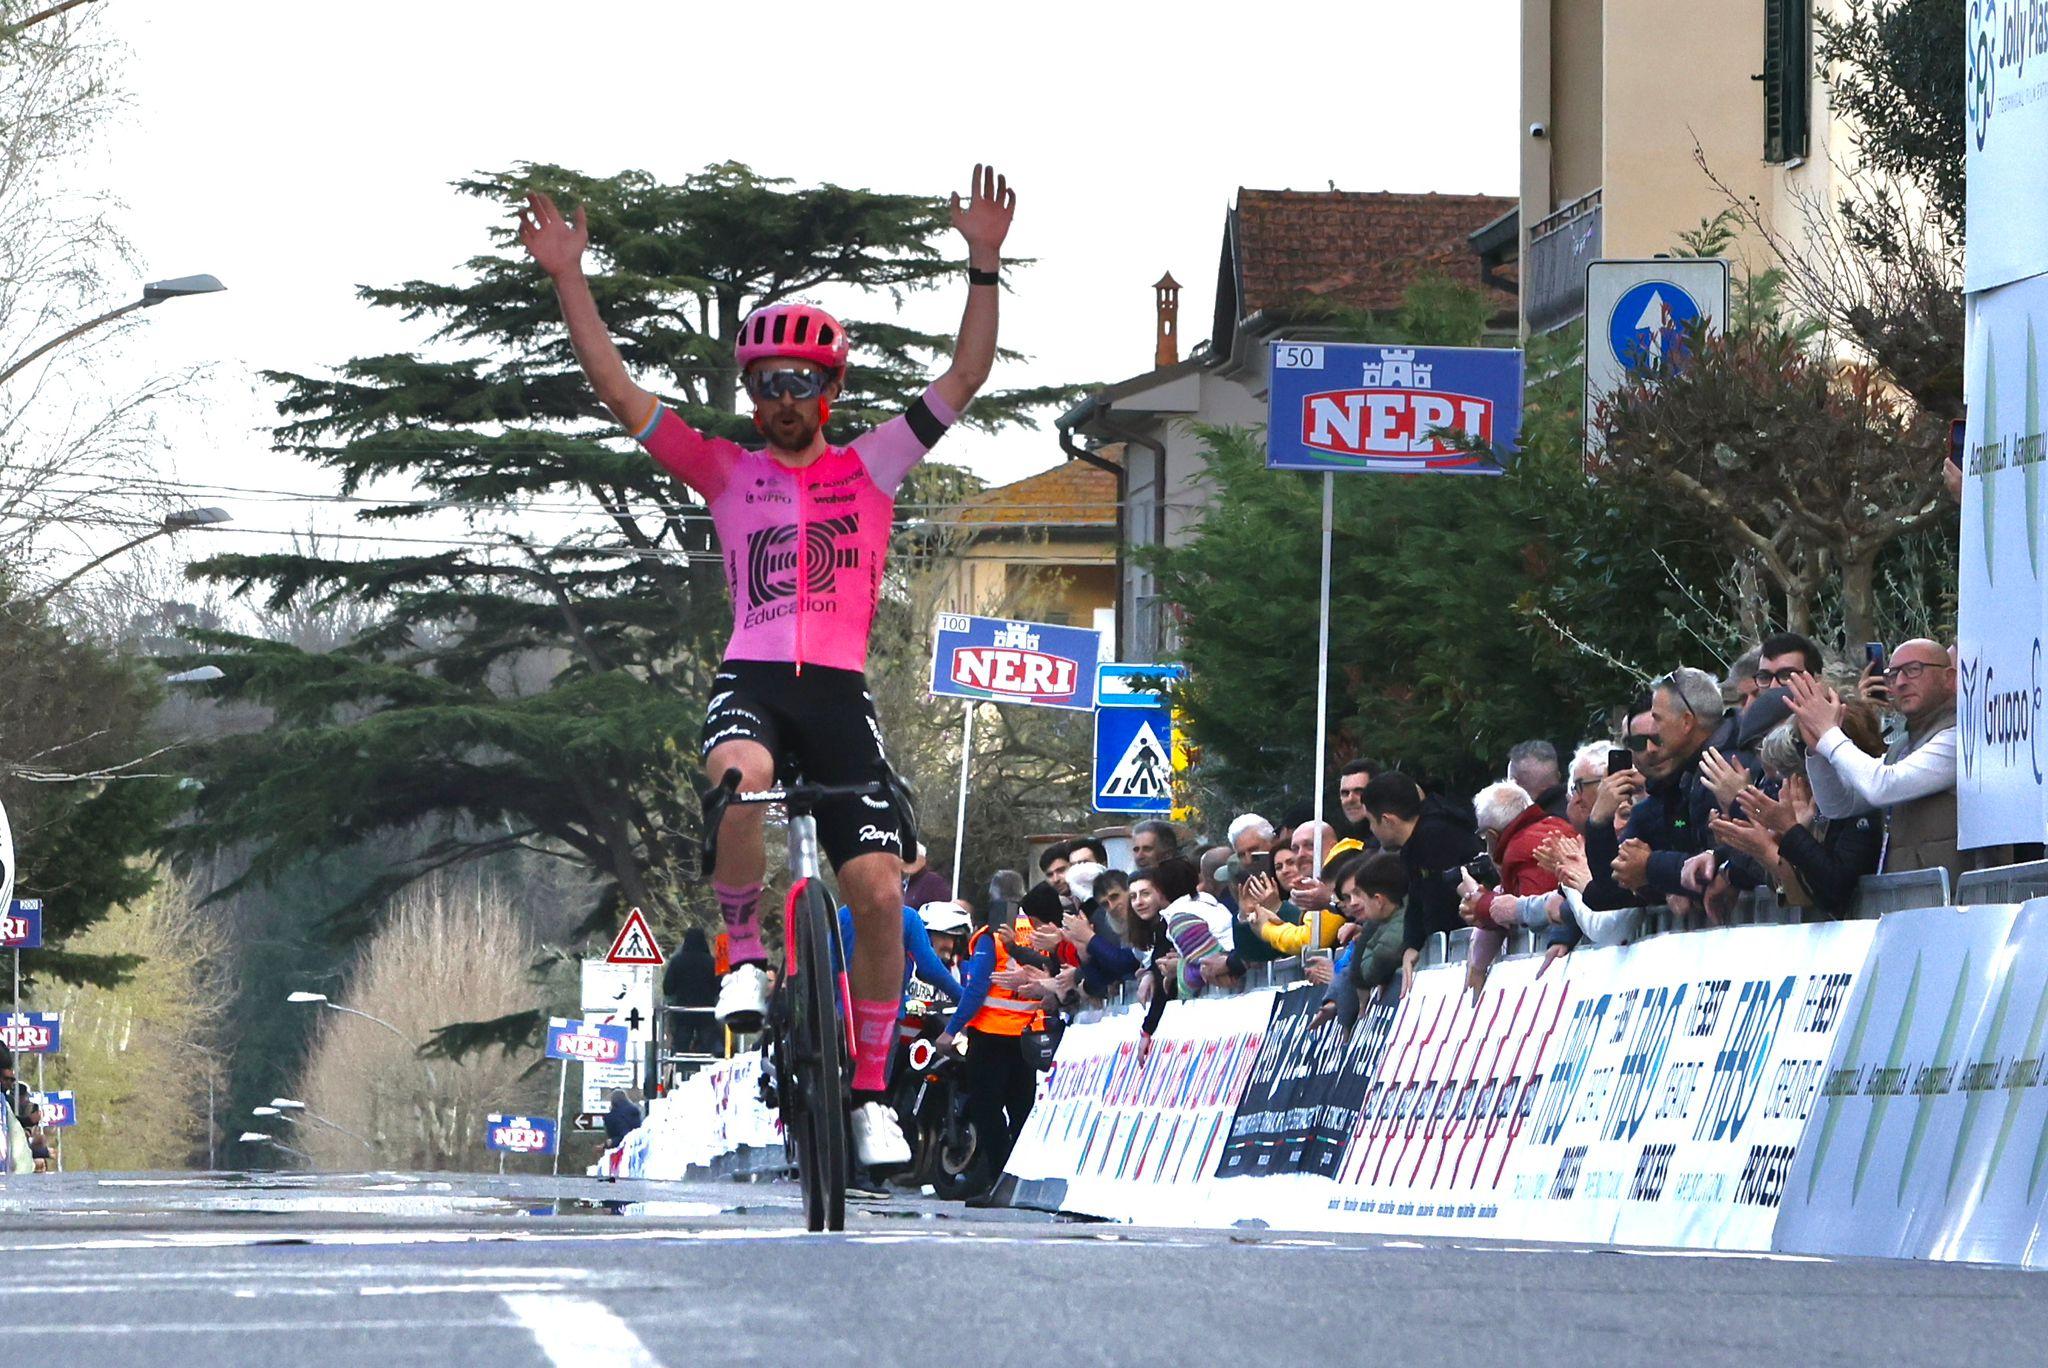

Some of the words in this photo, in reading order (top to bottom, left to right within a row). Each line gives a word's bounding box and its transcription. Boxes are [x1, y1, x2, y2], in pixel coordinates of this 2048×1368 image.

[1999, 0, 2026, 78] Jolly
[1287, 348, 1313, 367] 50
[1309, 394, 1486, 453] NERI
[743, 598, 837, 630] Education
[941, 617, 967, 631] 100
[956, 650, 1073, 694] NERI
[1984, 666, 2028, 768] Gruppo
[1812, 973, 1853, 1033] BEST
[558, 1035, 618, 1060] NERI
[1693, 976, 1796, 1142] FABO
[1763, 1059, 1824, 1120] CREATIVE
[494, 1128, 547, 1148] NERI
[1627, 1145, 1677, 1202] PROCESS
[1733, 1146, 1797, 1207] PROCESS
